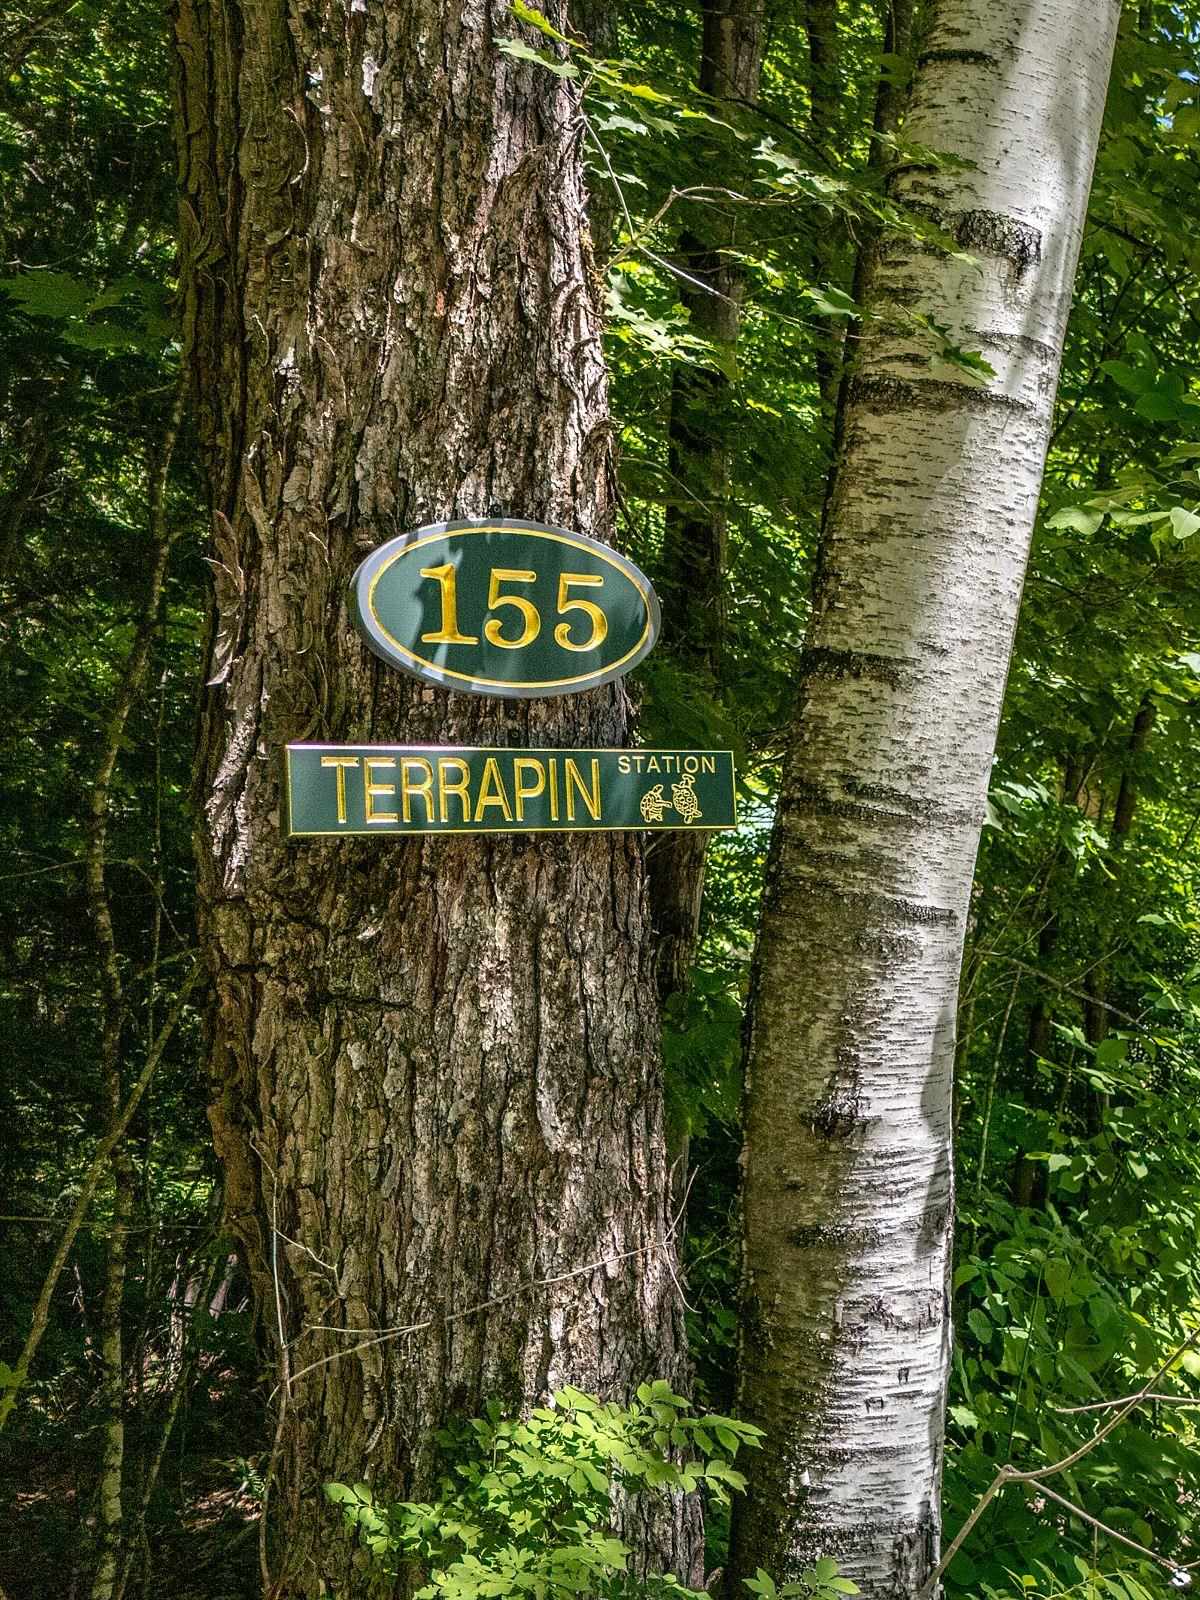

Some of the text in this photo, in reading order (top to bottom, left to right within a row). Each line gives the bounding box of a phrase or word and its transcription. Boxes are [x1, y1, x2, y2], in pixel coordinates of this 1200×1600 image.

[419, 563, 609, 652] 155
[320, 755, 716, 824] TERRAPIN STATION
